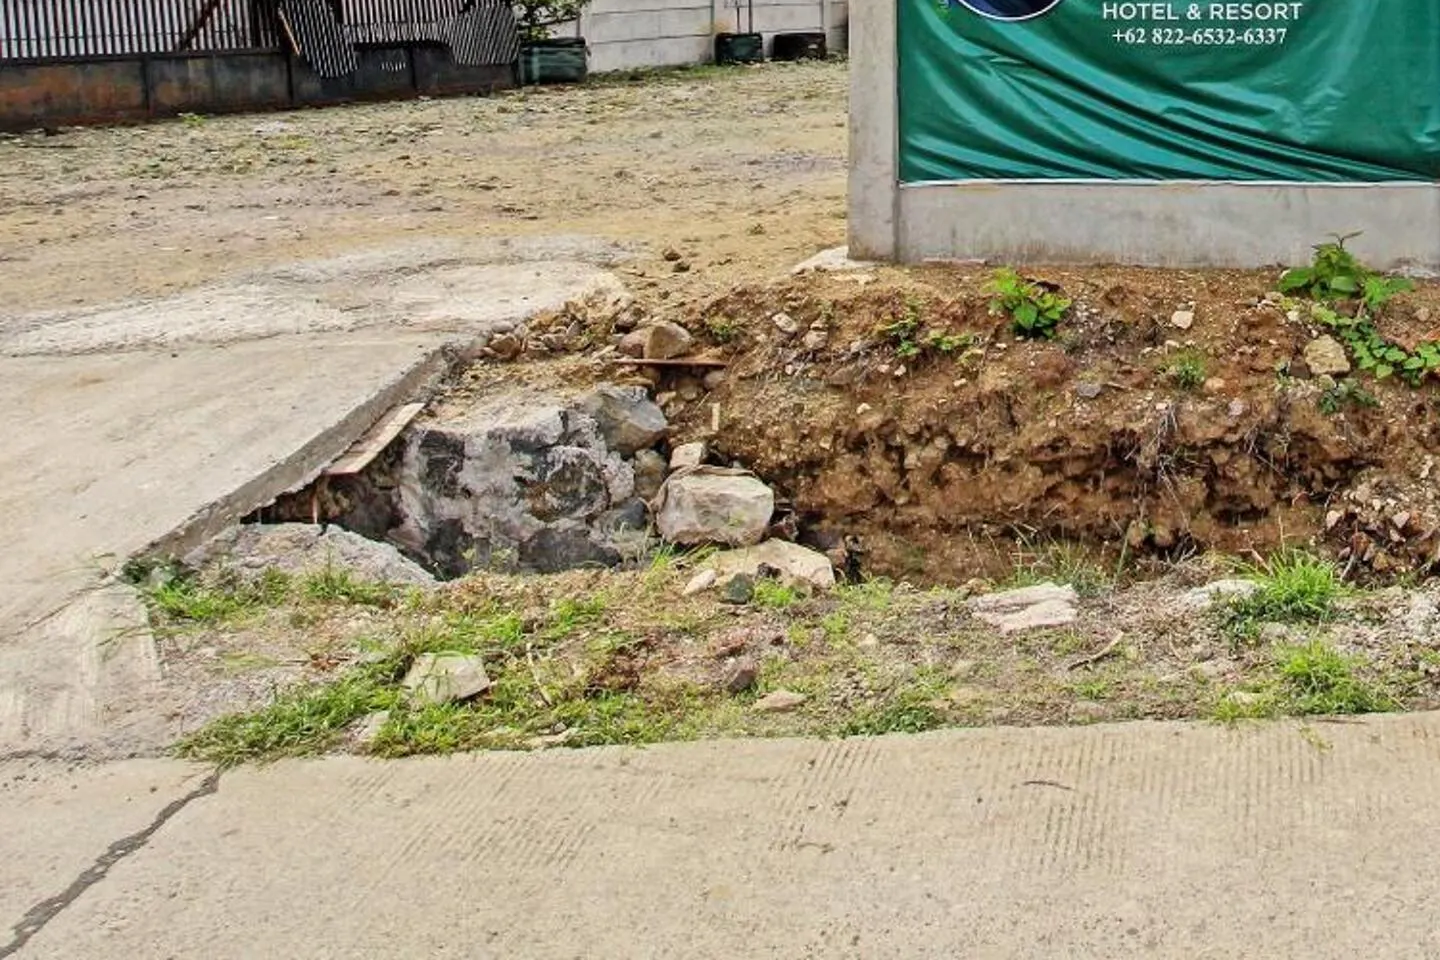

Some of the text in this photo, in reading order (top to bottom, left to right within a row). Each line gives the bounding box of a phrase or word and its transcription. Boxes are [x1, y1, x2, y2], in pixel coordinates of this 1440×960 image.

[1102, 2, 1304, 21] HOTEL & RESORT
[1112, 28, 1288, 45] +62 822-6532-6337
